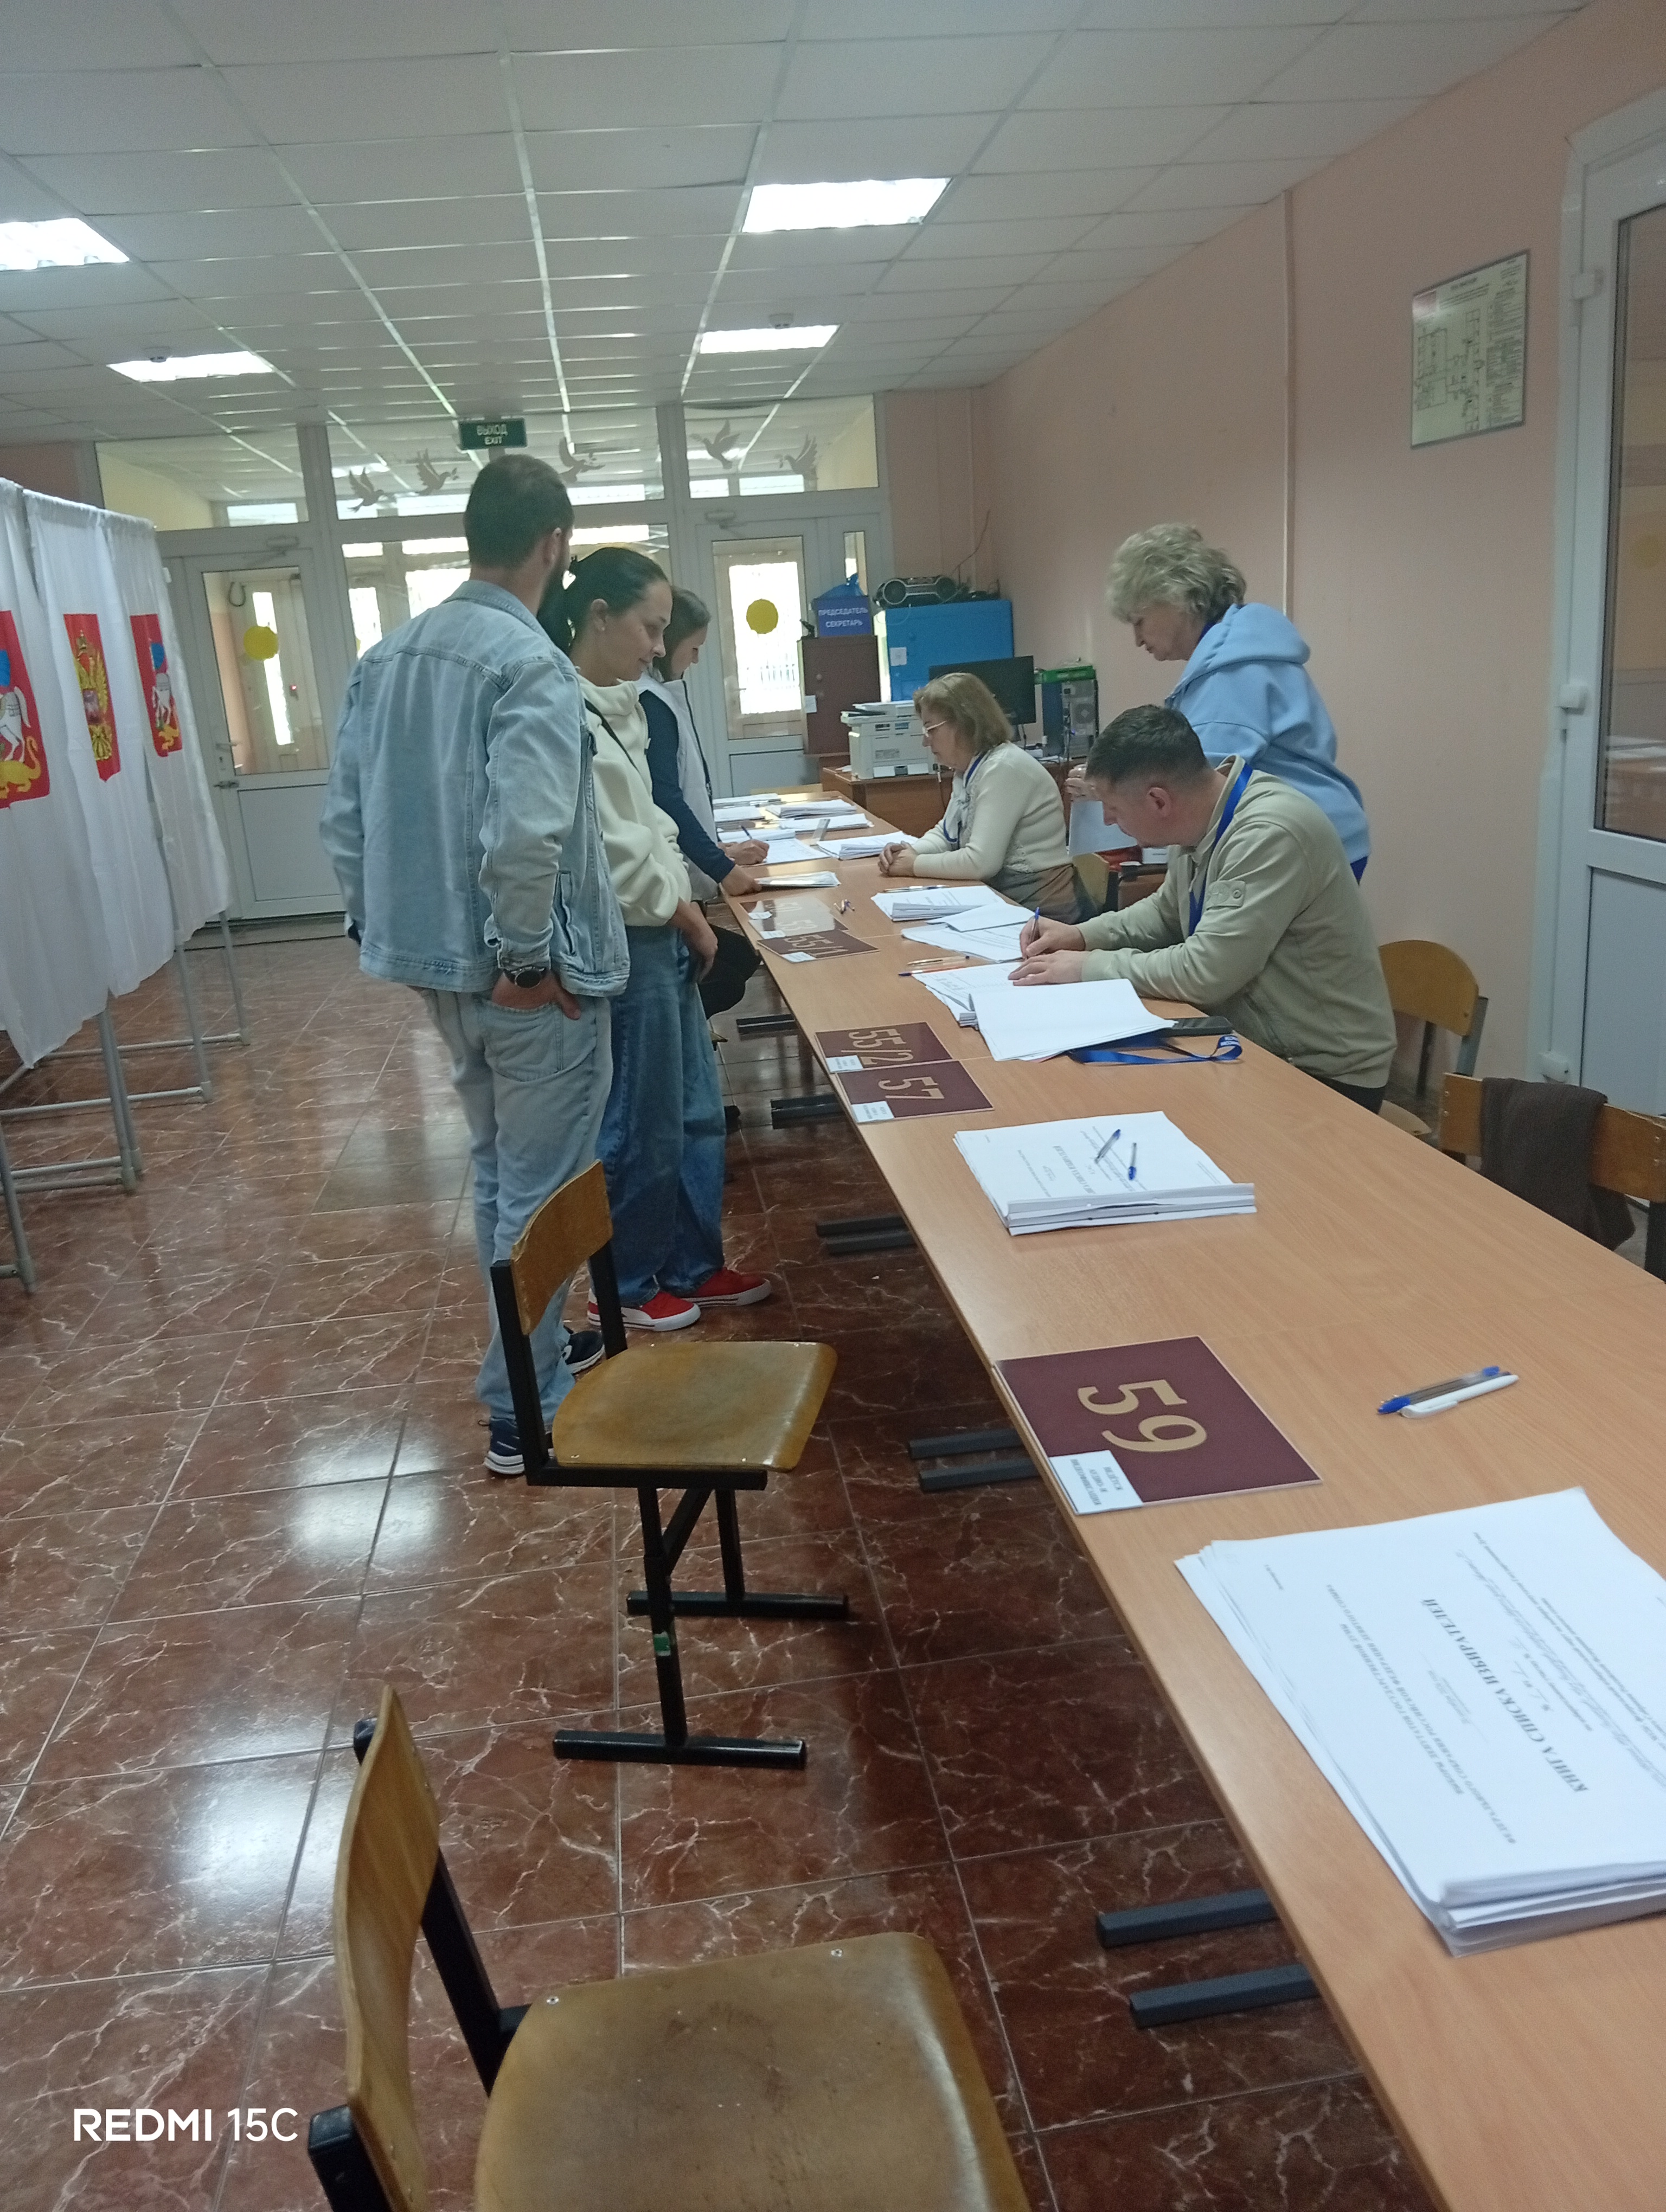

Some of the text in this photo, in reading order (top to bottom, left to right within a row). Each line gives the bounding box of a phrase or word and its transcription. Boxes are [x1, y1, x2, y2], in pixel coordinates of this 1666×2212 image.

[484, 436, 503, 445] EXIT
[818, 607, 868, 616] ПРЕДСЕДАТЕЛЬ
[825, 620, 863, 628] СЕКРЕТАРЬ
[784, 934, 848, 957] 55/1
[841, 1028, 914, 1066] 55/2
[877, 1076, 945, 1100] 57
[1077, 1379, 1207, 1452] 59
[1422, 1597, 1500, 1684] ИЗБИРАТЕЛЕЙ
[1495, 1688, 1546, 1742] СПИСКА
[1541, 1746, 1589, 1792] КНИГА
